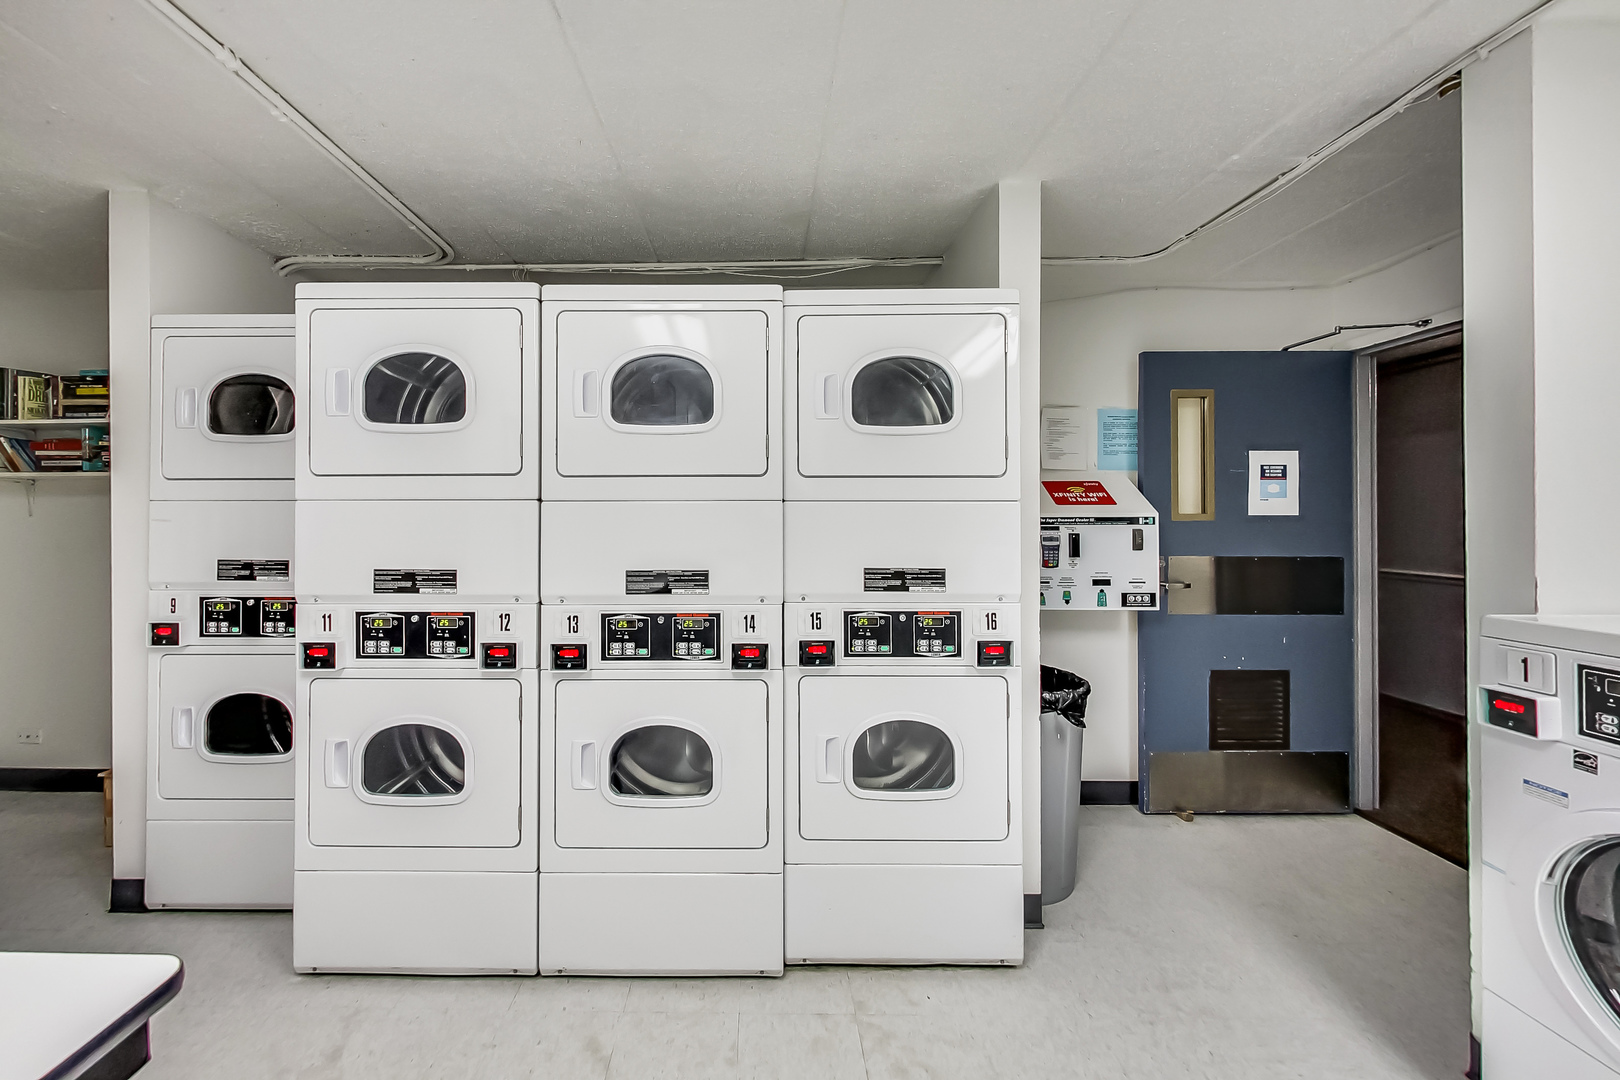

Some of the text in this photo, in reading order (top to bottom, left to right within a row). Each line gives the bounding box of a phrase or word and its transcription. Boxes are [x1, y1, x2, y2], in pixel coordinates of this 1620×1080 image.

[171, 598, 177, 614] 9
[321, 613, 332, 632] 11
[373, 619, 383, 627] 25
[439, 619, 449, 627] 25
[498, 613, 511, 632] 12
[566, 615, 579, 634] 13
[743, 615, 756, 634] 14
[809, 612, 822, 631] 15
[985, 612, 997, 631] 16
[1521, 657, 1529, 683] 1
